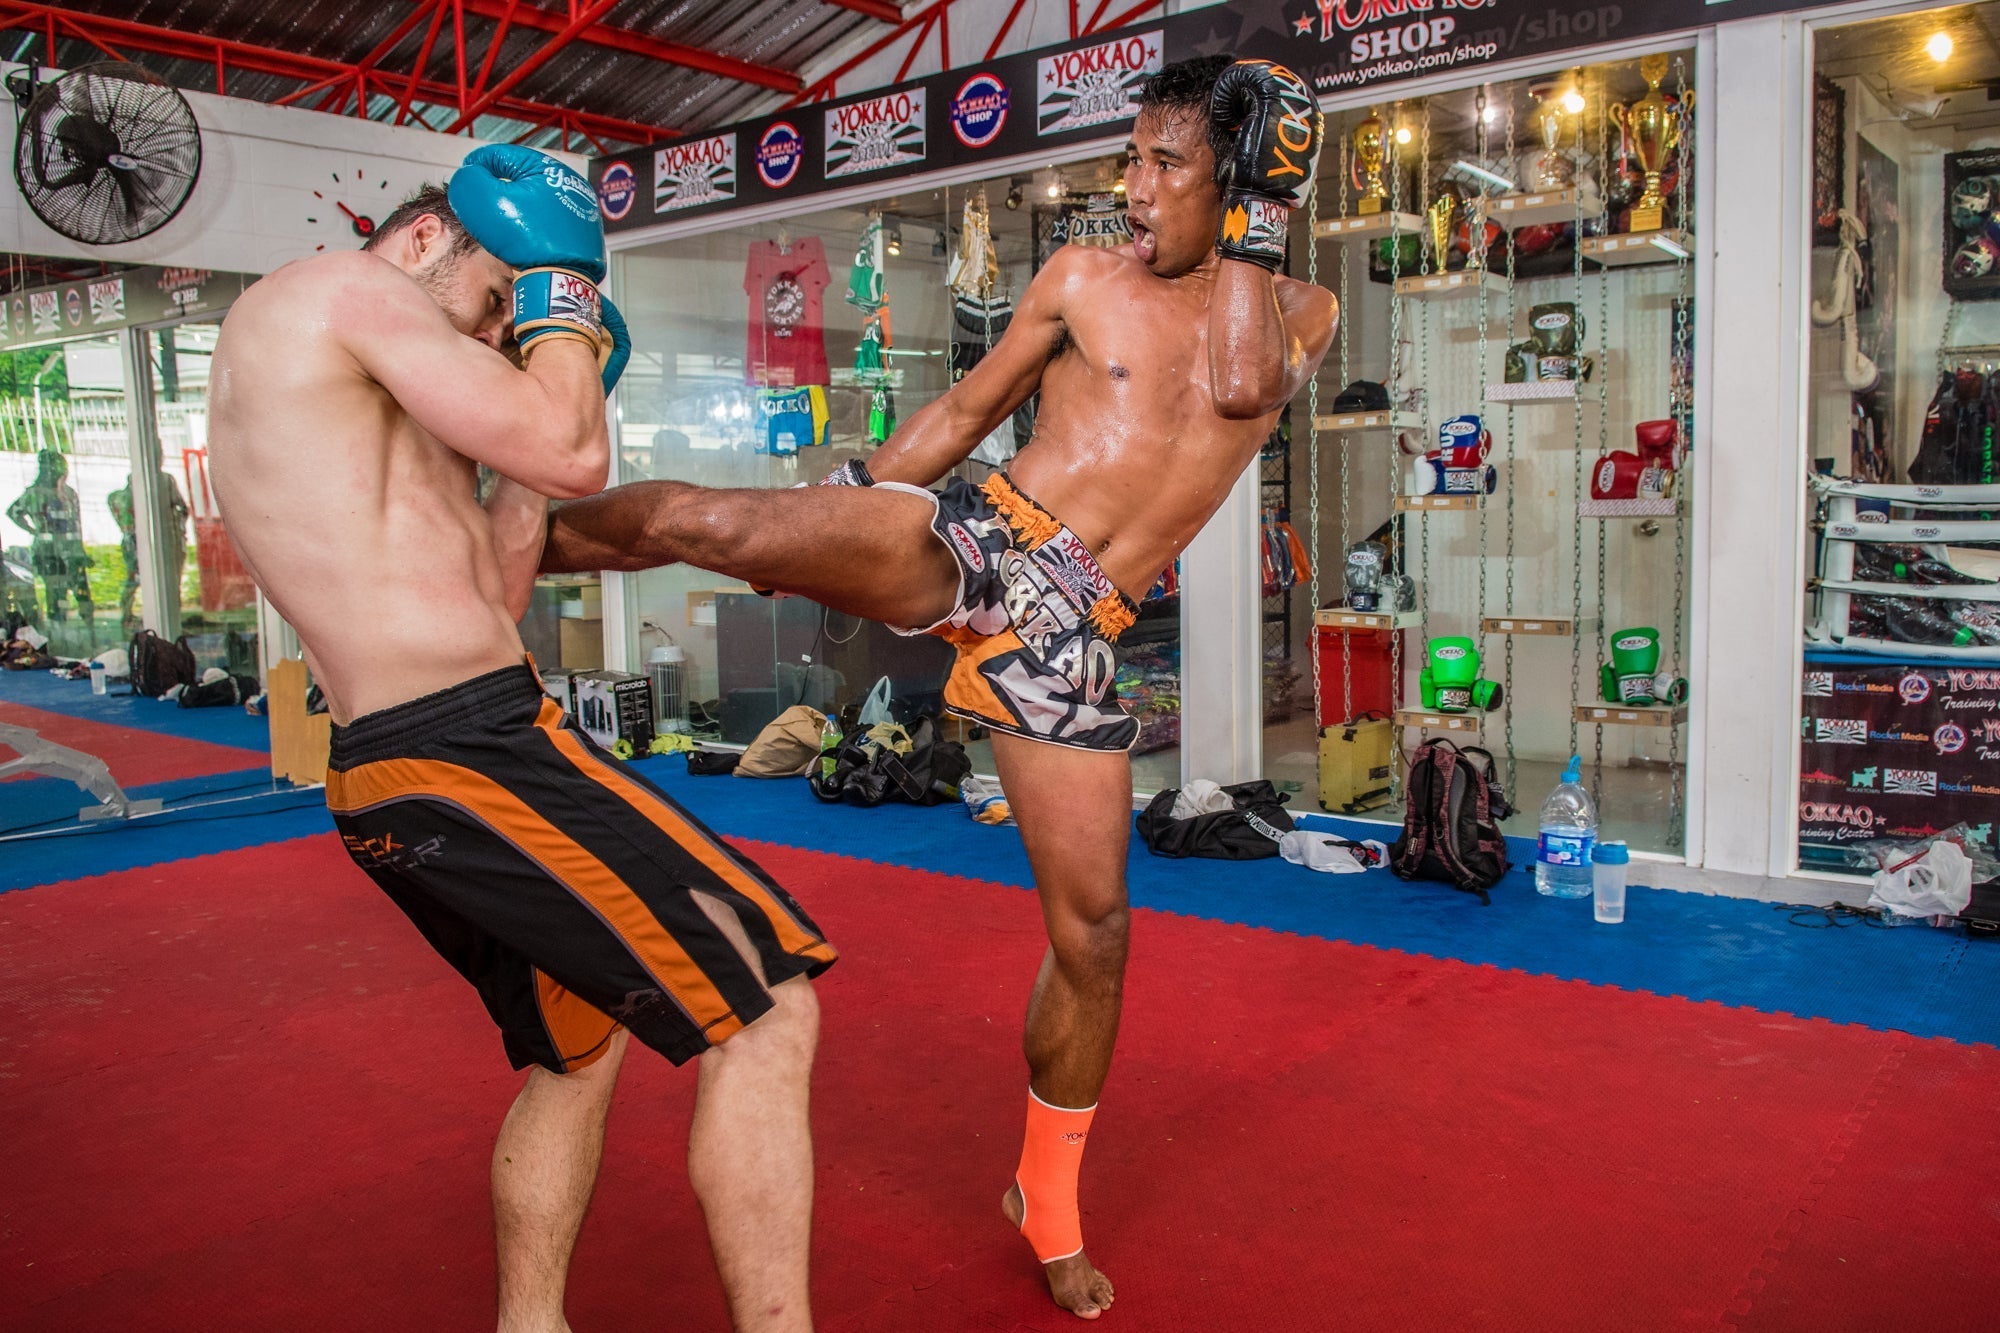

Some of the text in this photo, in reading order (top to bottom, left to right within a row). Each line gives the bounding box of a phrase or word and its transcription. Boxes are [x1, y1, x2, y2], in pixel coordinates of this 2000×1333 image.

[1351, 16, 1455, 63] SHOP
[1053, 38, 1145, 88] YOKKAO
[1315, 42, 1497, 88] www.yokkao.com/shop
[957, 92, 1001, 115] YOKKAO
[838, 93, 910, 136] YOKKAO
[966, 110, 993, 124] SHOP
[665, 138, 724, 174] YOKKAO
[762, 141, 797, 159] YOKKAO
[768, 156, 789, 167] SHOP
[608, 192, 626, 202] SHOP
[518, 287, 525, 300] 14
[767, 281, 804, 301] YOKKAO
[1063, 537, 1107, 591] YOKKAO
[615, 680, 648, 692] microlab
[1835, 682, 1894, 692] Rocket Media
[1940, 695, 1996, 712] Training
[1869, 730, 1900, 740] Rocket
[1901, 732, 1929, 741] Media
[1891, 768, 1929, 783] YOKKAO
[1938, 782, 2000, 795] Rocket Media
[1836, 826, 1875, 840] Center
